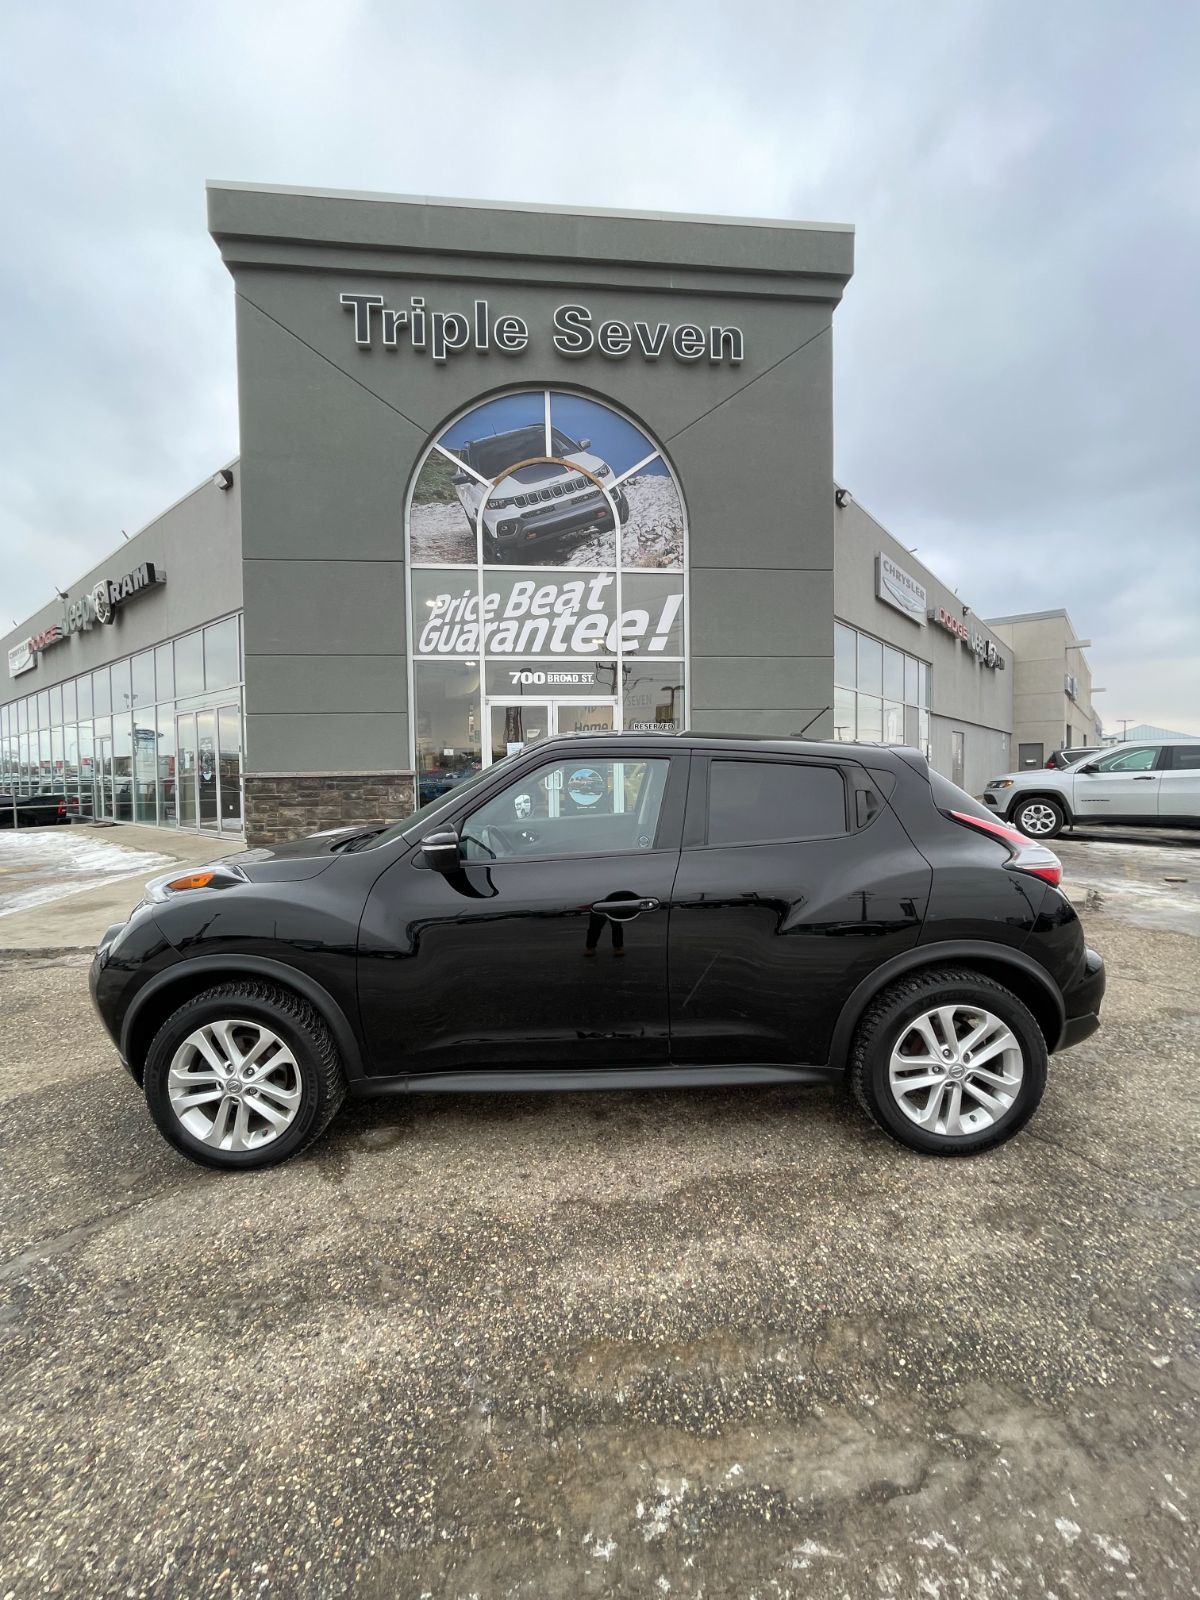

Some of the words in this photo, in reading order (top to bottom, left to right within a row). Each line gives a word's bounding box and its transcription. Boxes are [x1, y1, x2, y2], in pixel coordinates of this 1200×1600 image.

[340, 293, 529, 360] Triple
[552, 303, 745, 361] Seven
[109, 562, 151, 604] RAM
[429, 589, 501, 623] Price
[503, 572, 614, 618] Beat
[882, 560, 926, 601] CHRYSLER
[418, 593, 684, 653] Guarantee!
[938, 606, 969, 641] DODGE
[508, 671, 546, 685] 700
[547, 674, 579, 683] BROAD
[581, 674, 595, 683] ST.
